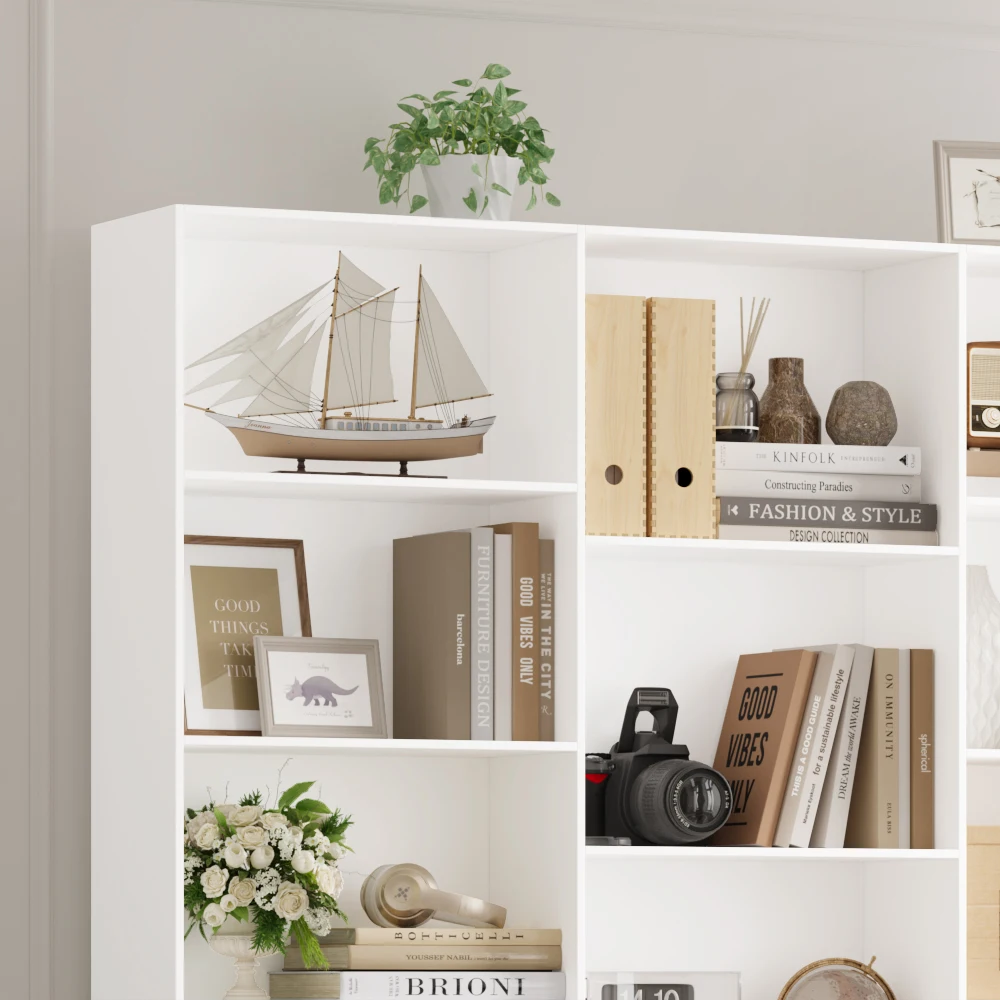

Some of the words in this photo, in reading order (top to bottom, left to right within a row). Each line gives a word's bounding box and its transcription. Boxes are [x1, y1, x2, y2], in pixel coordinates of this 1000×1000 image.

[773, 451, 836, 464] KINFOLK
[764, 478, 816, 493] Constructing
[819, 481, 853, 492] Paradies
[749, 504, 836, 522] FASHION
[842, 506, 856, 522] &
[862, 507, 922, 524] STYLE
[790, 530, 818, 542] DESIGN
[821, 530, 869, 544] COLLECTION
[477, 545, 490, 654] FURNITURE
[520, 577, 534, 607] GOOD
[214, 598, 260, 613] GOOD
[541, 604, 552, 620] IN
[210, 620, 268, 634] THINGS
[520, 616, 534, 649] VIBES
[220, 642, 254, 656] TAK
[456, 613, 465, 666] barcelona
[541, 626, 552, 657] THE
[224, 664, 256, 678] TIM
[520, 658, 534, 685] ONLY
[886, 673, 894, 689] ON
[541, 663, 552, 700] CITY
[477, 660, 490, 728] DESIGN
[738, 684, 778, 722] GOOD
[810, 695, 822, 725] GUIDE
[813, 762, 821, 776] for
[820, 704, 836, 753] sustainable
[830, 668, 844, 702] lifestyle
[886, 696, 894, 760] IMMUNITY
[725, 731, 769, 768] VIBES
[802, 726, 814, 754] GOOD
[800, 756, 806, 764] A
[918, 733, 931, 772] spherical
[797, 766, 804, 776] IS
[792, 776, 802, 796] THIS
[394, 930, 524, 941] BOTTICELLI
[406, 954, 445, 962] YOUSSEF
[446, 954, 473, 962] NABIL
[405, 977, 526, 997] BRIONI
